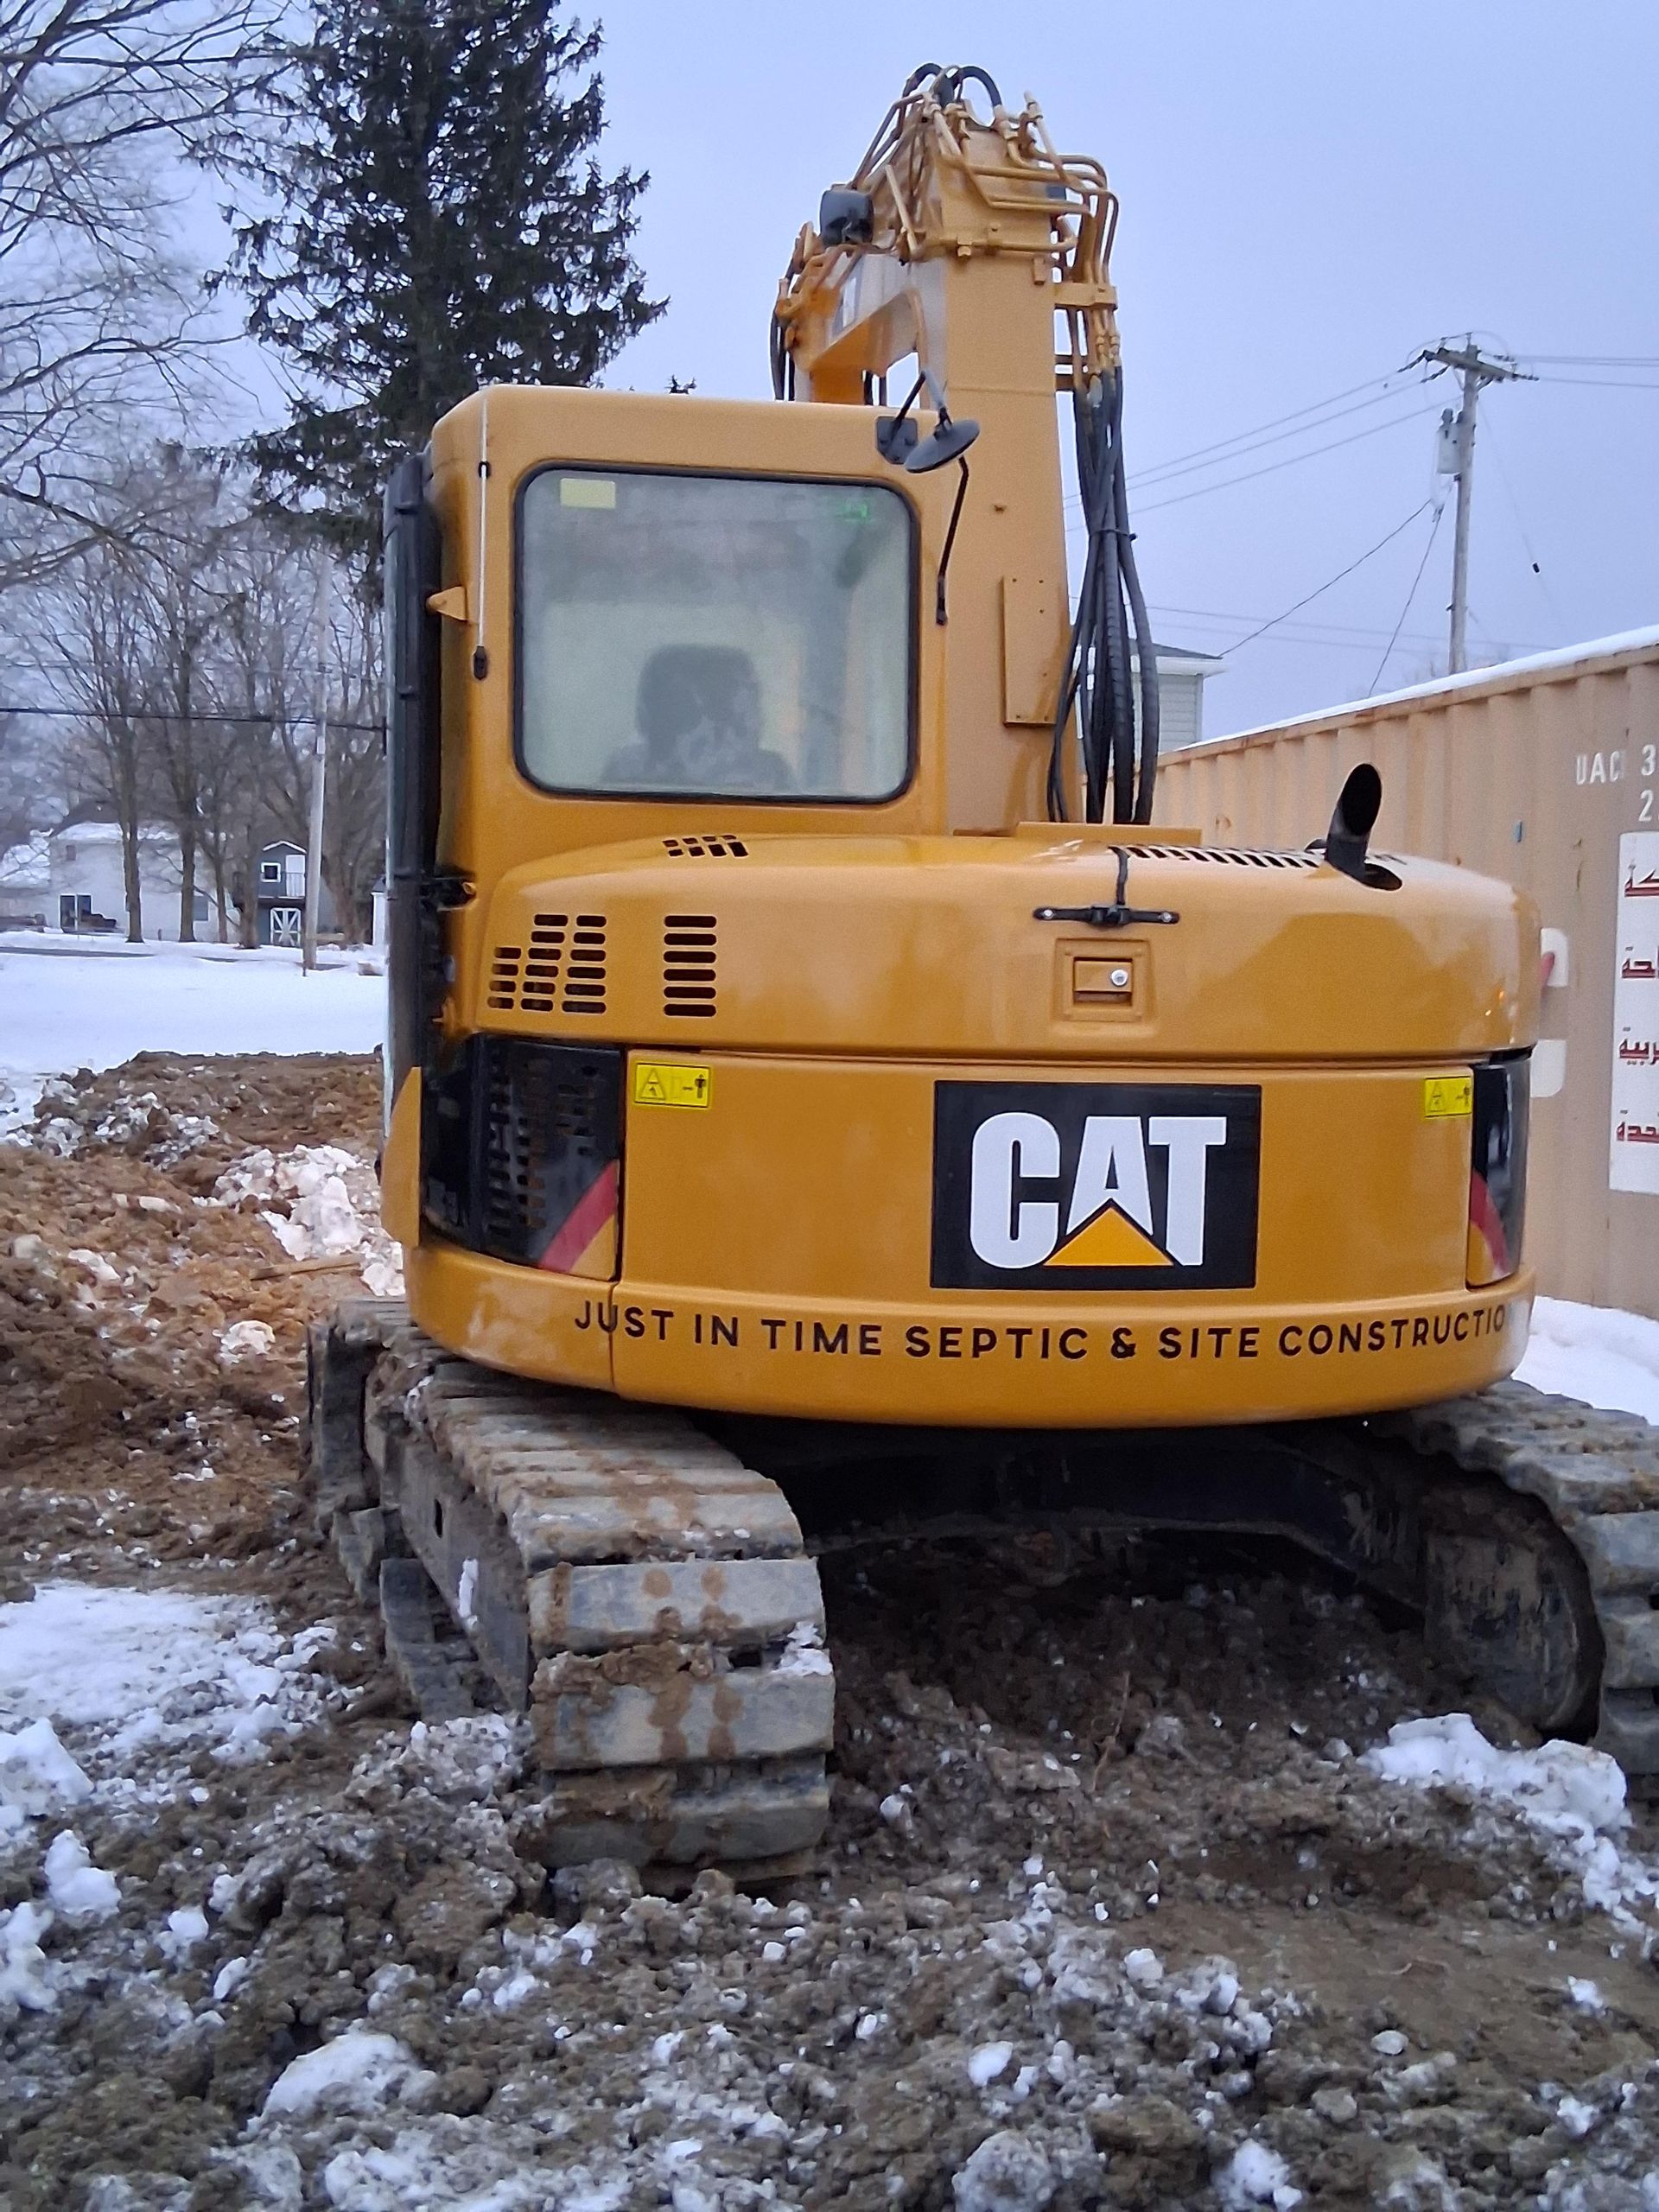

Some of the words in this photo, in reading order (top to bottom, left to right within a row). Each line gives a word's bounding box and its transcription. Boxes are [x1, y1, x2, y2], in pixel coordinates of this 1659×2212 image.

[969, 1111, 1227, 1269] CAT
[574, 1300, 675, 1341] JUST
[694, 1313, 740, 1347] IN
[760, 1318, 883, 1356] TIME
[905, 1325, 1089, 1360] SEPTIC
[1109, 1326, 1136, 1359] &
[1158, 1326, 1260, 1359] SITE
